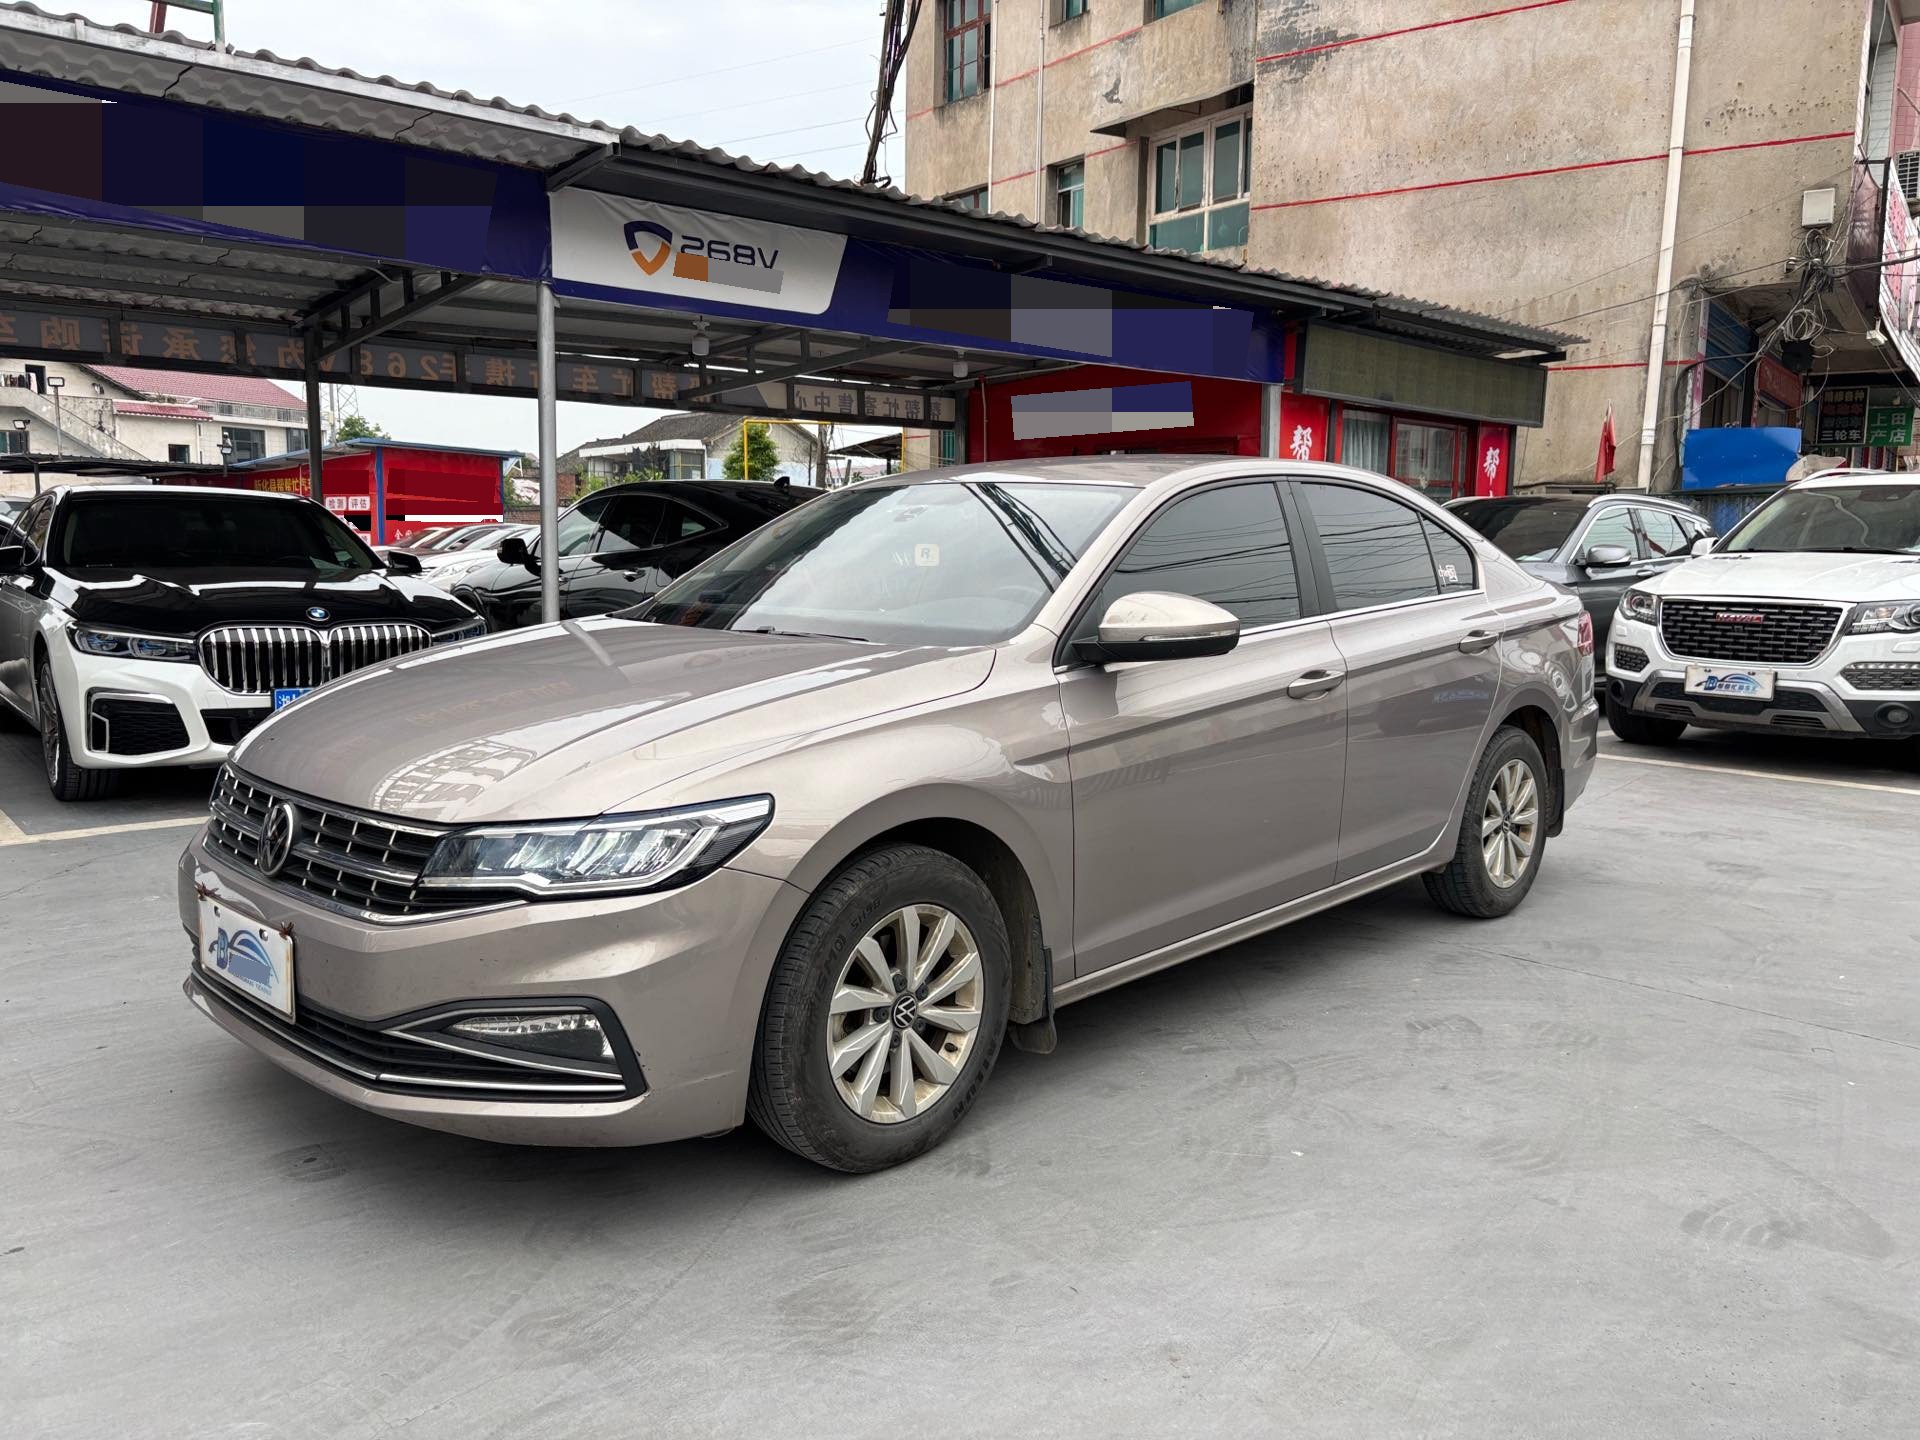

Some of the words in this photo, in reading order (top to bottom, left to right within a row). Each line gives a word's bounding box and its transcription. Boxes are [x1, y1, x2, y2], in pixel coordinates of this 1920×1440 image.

[680, 234, 778, 270] 268V
[1821, 430, 1861, 441] 三轮车
